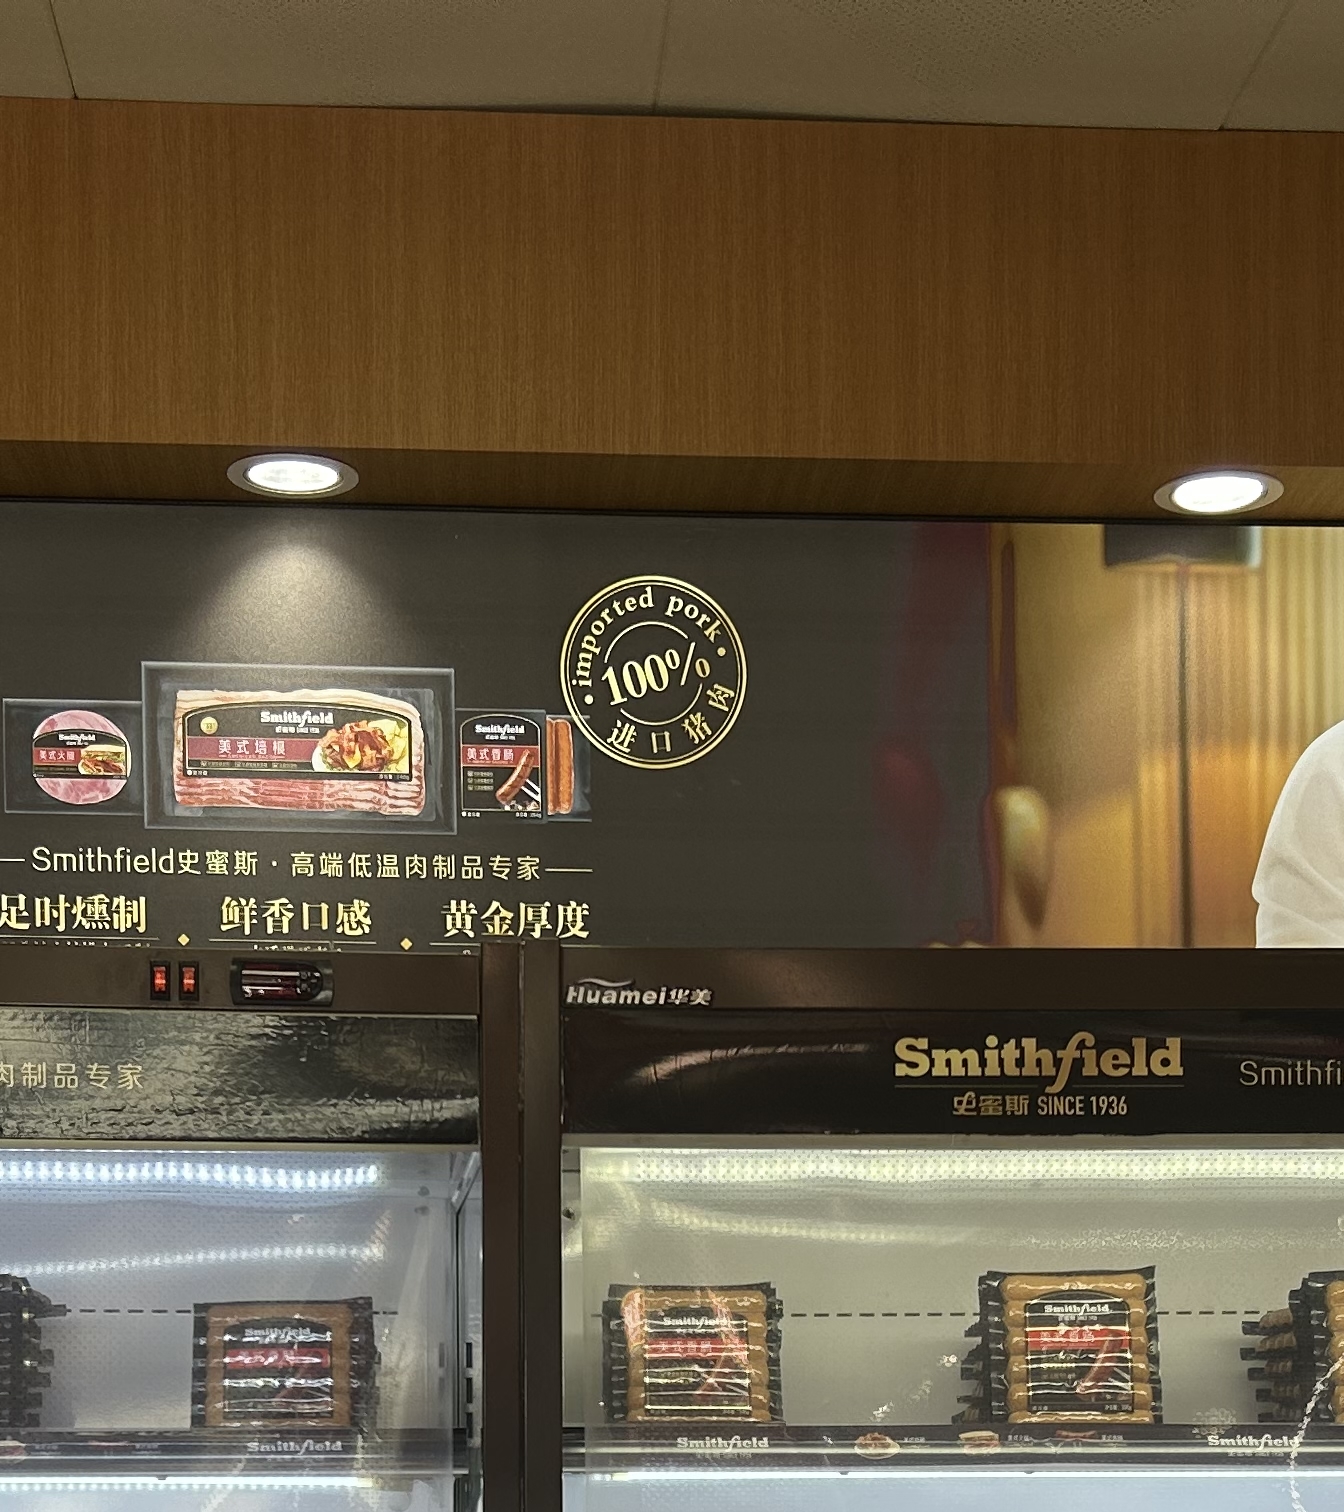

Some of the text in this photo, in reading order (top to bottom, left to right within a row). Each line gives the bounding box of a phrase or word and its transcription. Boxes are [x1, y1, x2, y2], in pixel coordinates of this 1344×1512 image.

[572, 586, 722, 687] imported pork
[601, 641, 711, 706] 100%
[260, 710, 335, 727] Smithfield
[607, 683, 735, 753] 进口猪肉
[220, 896, 372, 937] 鲜香口感
[441, 899, 590, 938] 黄金厚度
[894, 1031, 1184, 1093] Smithfield
[1037, 1095, 1085, 1117] SINCE
[1089, 1095, 1128, 1117] 1936
[1044, 1303, 1110, 1316] Smithfield
[676, 1436, 769, 1452] Smithfield
